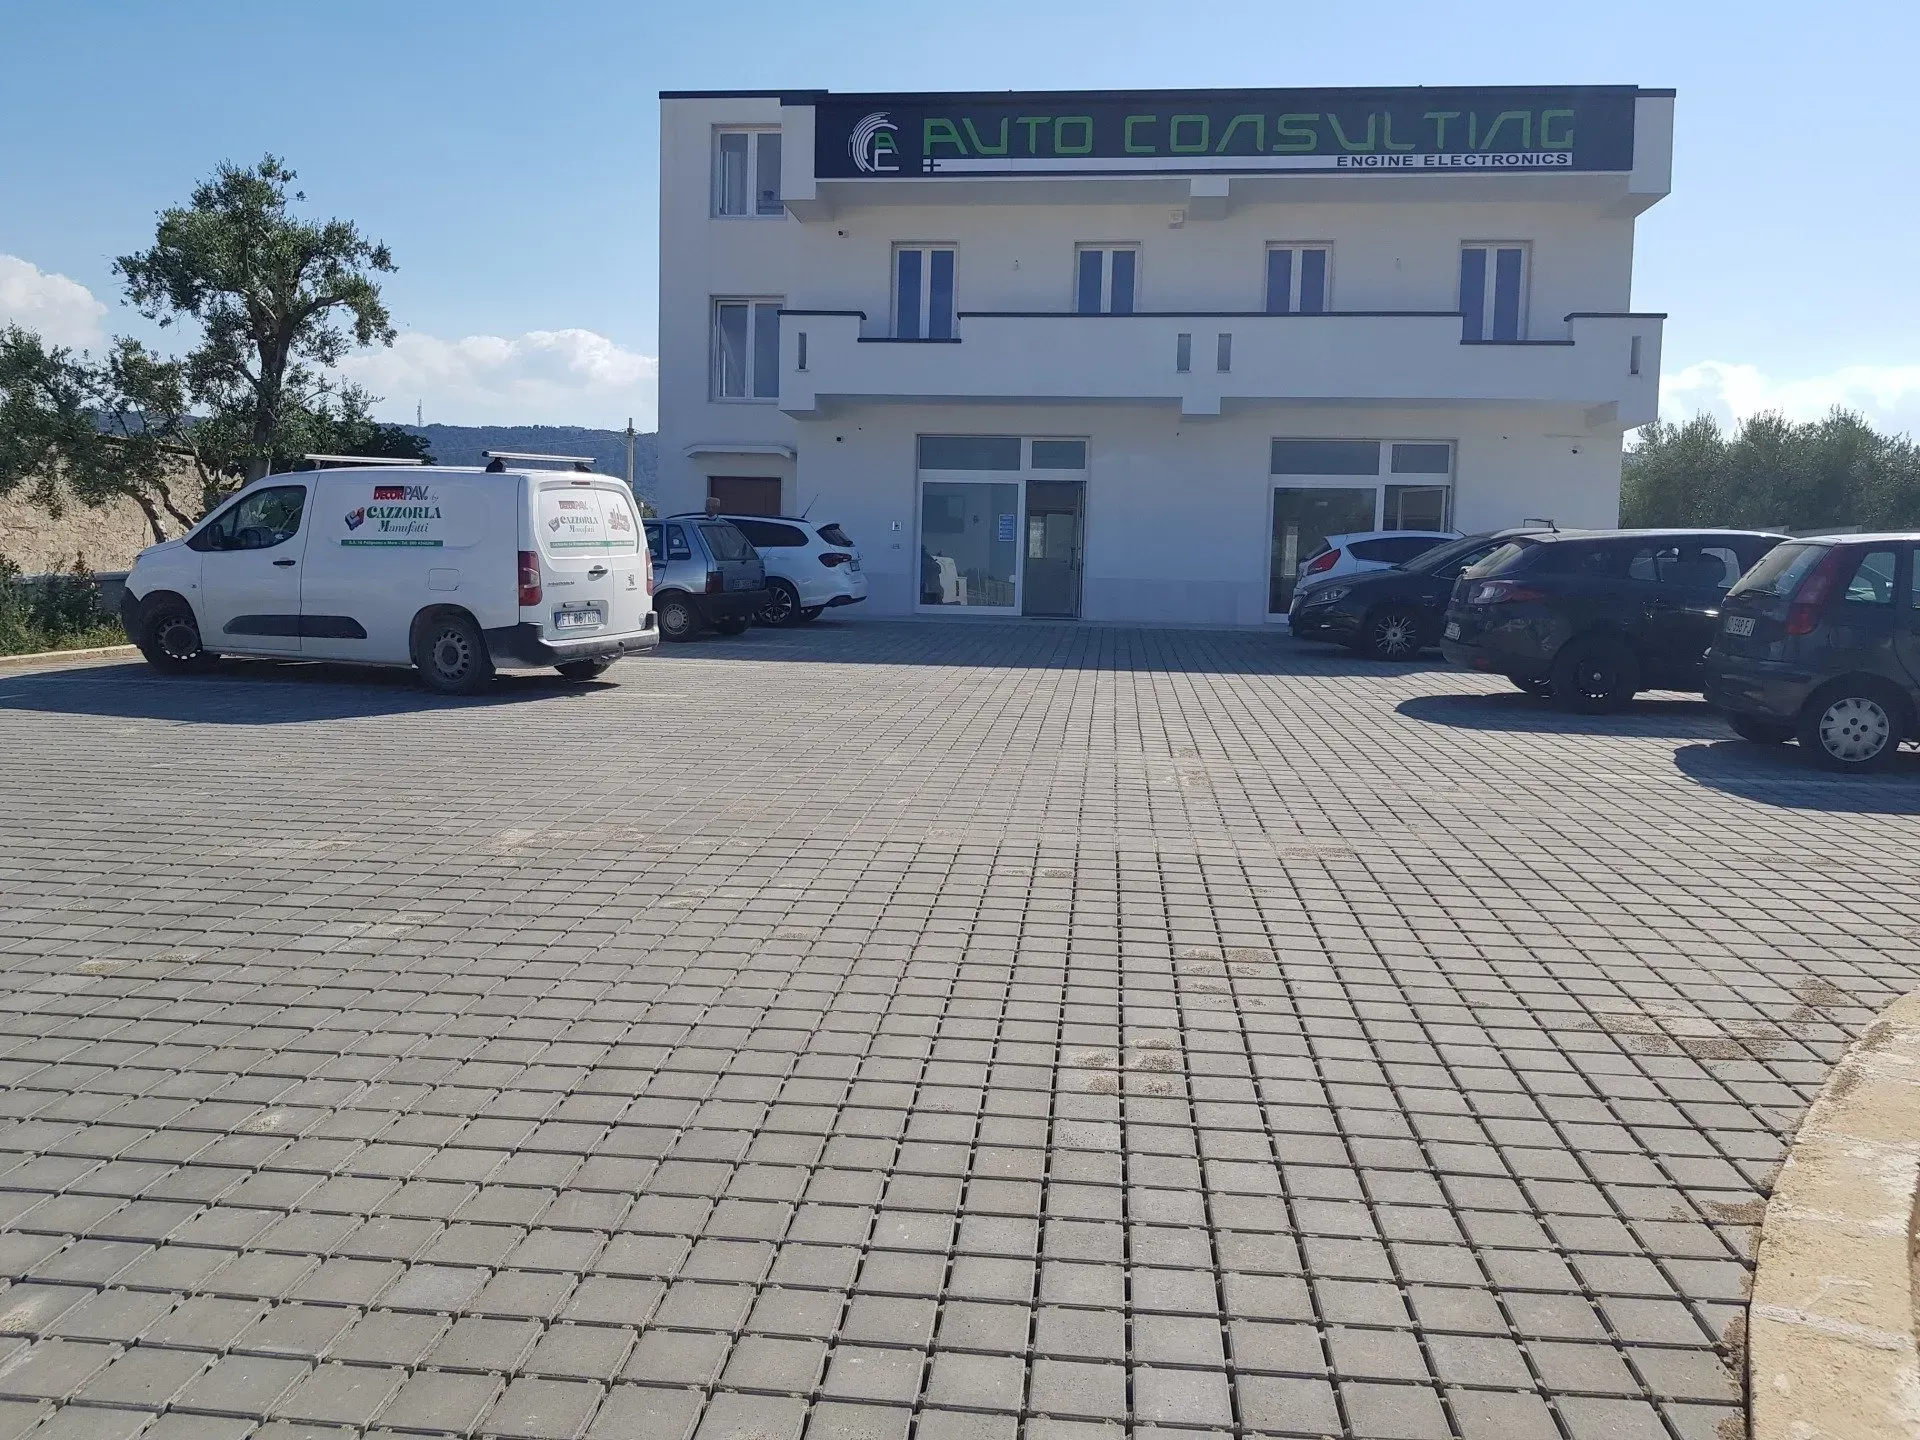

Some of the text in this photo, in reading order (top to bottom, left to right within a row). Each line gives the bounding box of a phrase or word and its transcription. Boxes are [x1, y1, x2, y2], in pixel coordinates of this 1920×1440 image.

[923, 109, 1575, 155] AUTO CONSULTING
[1336, 153, 1569, 167] ENGINE ELECTRONICS
[366, 506, 442, 519] CAZZORLA
[378, 520, 429, 535] Manufatti
